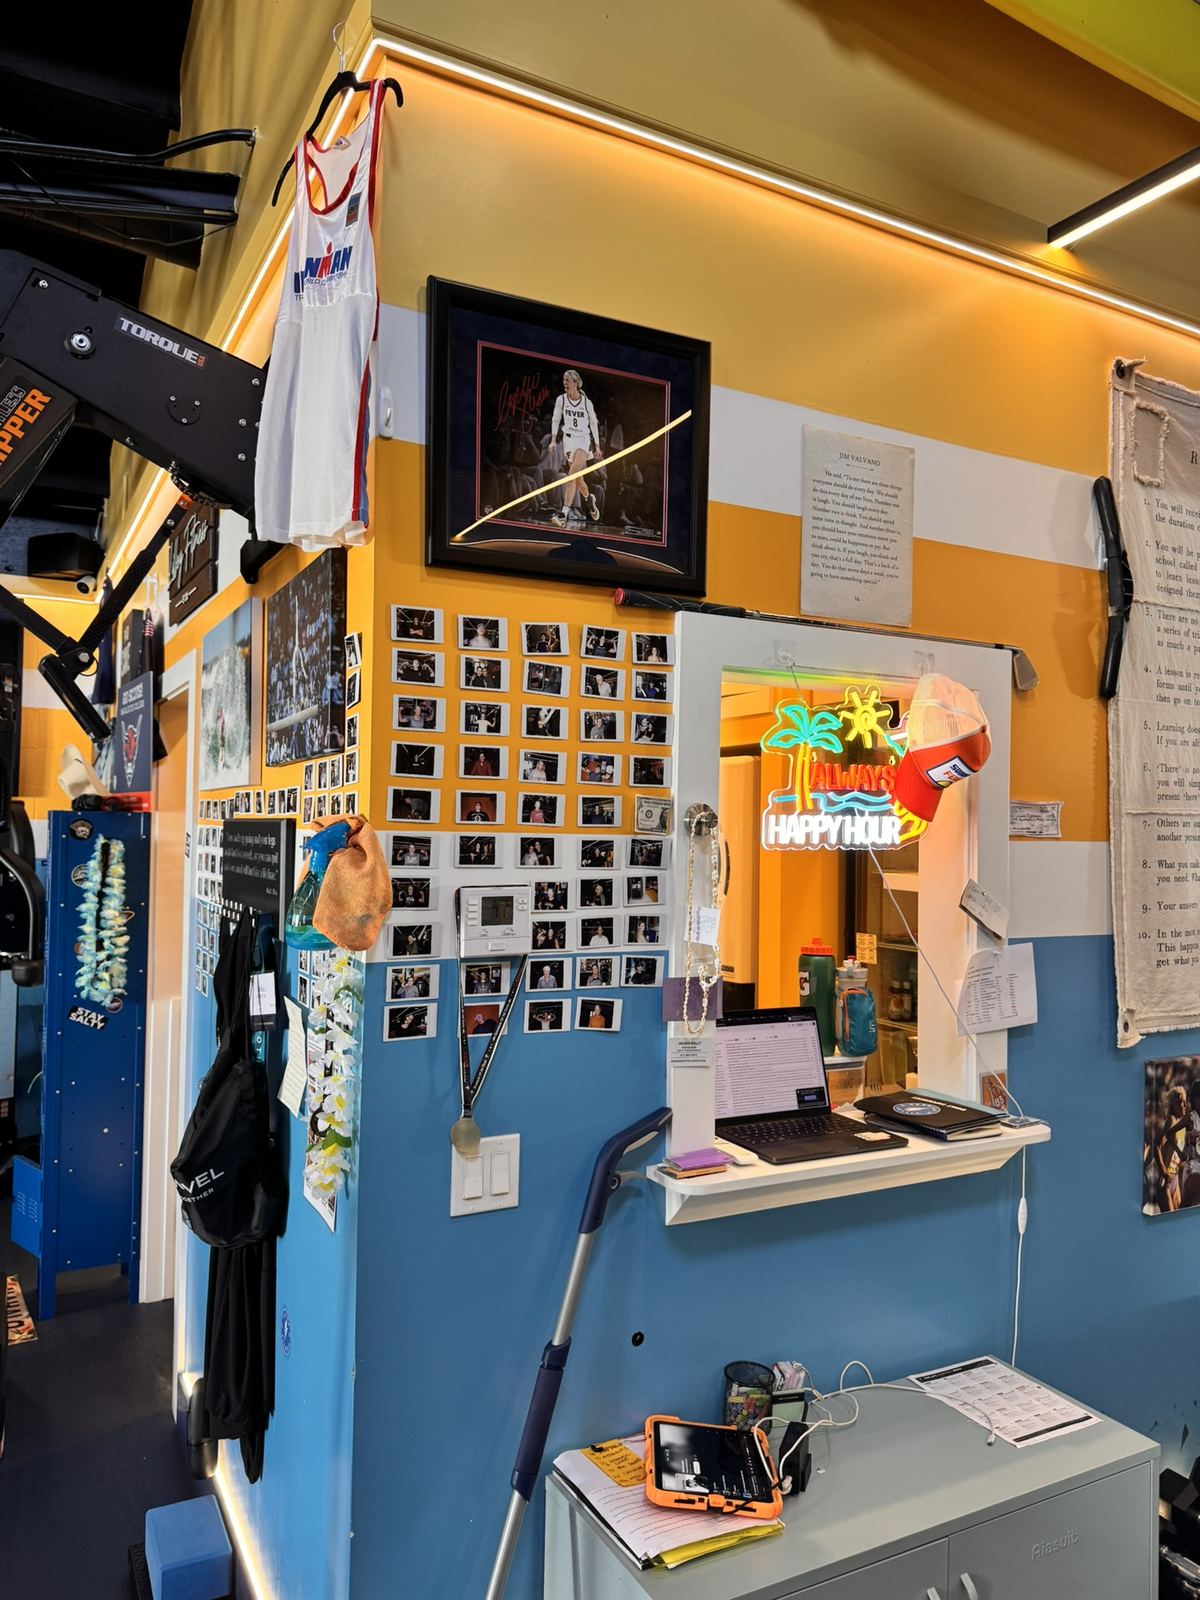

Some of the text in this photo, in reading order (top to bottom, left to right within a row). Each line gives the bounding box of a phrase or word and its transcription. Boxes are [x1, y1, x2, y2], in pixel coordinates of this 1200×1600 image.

[120, 316, 199, 364] TORQUE
[565, 409, 585, 418] FEVER
[573, 418, 578, 427] 8
[839, 452, 881, 466] JIM VALVANO
[1156, 498, 1169, 511] You
[1171, 504, 1183, 514] will
[1156, 512, 1166, 524] the
[1169, 516, 1195, 531] duration
[1155, 540, 1169, 552] You
[1172, 545, 1184, 556] will
[1187, 547, 1194, 558] be
[1156, 555, 1198, 572] school called
[1156, 570, 1162, 578] to
[1167, 570, 1183, 582] learn
[1156, 582, 1184, 597] designed
[1157, 609, 1176, 622] There
[1178, 616, 1189, 624] are
[1191, 618, 1199, 626] no
[1164, 626, 1181, 637] series
[1184, 628, 1191, 638] of
[1157, 640, 1164, 648] as
[1167, 640, 1185, 651] much
[1157, 665, 1162, 675] A
[1165, 665, 1184, 678] lesson
[1186, 669, 1192, 679] is
[1157, 679, 1175, 690] forms
[1178, 682, 1192, 693] until
[1157, 692, 1171, 704] then
[1173, 697, 1182, 707] go
[1184, 698, 1192, 706] on
[1144, 720, 1152, 731] 5.
[1157, 721, 1185, 735] Learning
[1157, 735, 1164, 745] If
[1165, 738, 1177, 749] you
[1180, 739, 1190, 747] are
[1144, 762, 1152, 773] 6.
[1185, 766, 1190, 774] is
[809, 762, 897, 791] ALWAYS
[1157, 780, 1170, 790] you
[1173, 777, 1185, 788] will
[1157, 793, 1181, 804] present
[767, 813, 902, 845] HAPPY HOUR
[1143, 820, 1151, 830] 7.
[1157, 818, 1180, 828] Others
[1182, 821, 1191, 829] are
[1157, 831, 1182, 842] another
[1142, 859, 1151, 870] 8.
[1157, 859, 1176, 869] What
[1178, 862, 1189, 872] you
[1157, 876, 1171, 887] you
[1142, 903, 1152, 914] 9.
[1157, 901, 1177, 911] Your
[1138, 931, 1151, 940] 10.
[1157, 929, 1168, 939] In
[1171, 928, 1183, 939] the
[1157, 943, 1177, 953] This
[1156, 958, 1171, 969] get
[1174, 955, 1190, 966] what
[69, 1012, 105, 1030] SALTY
[76, 1006, 105, 1022] STAY
